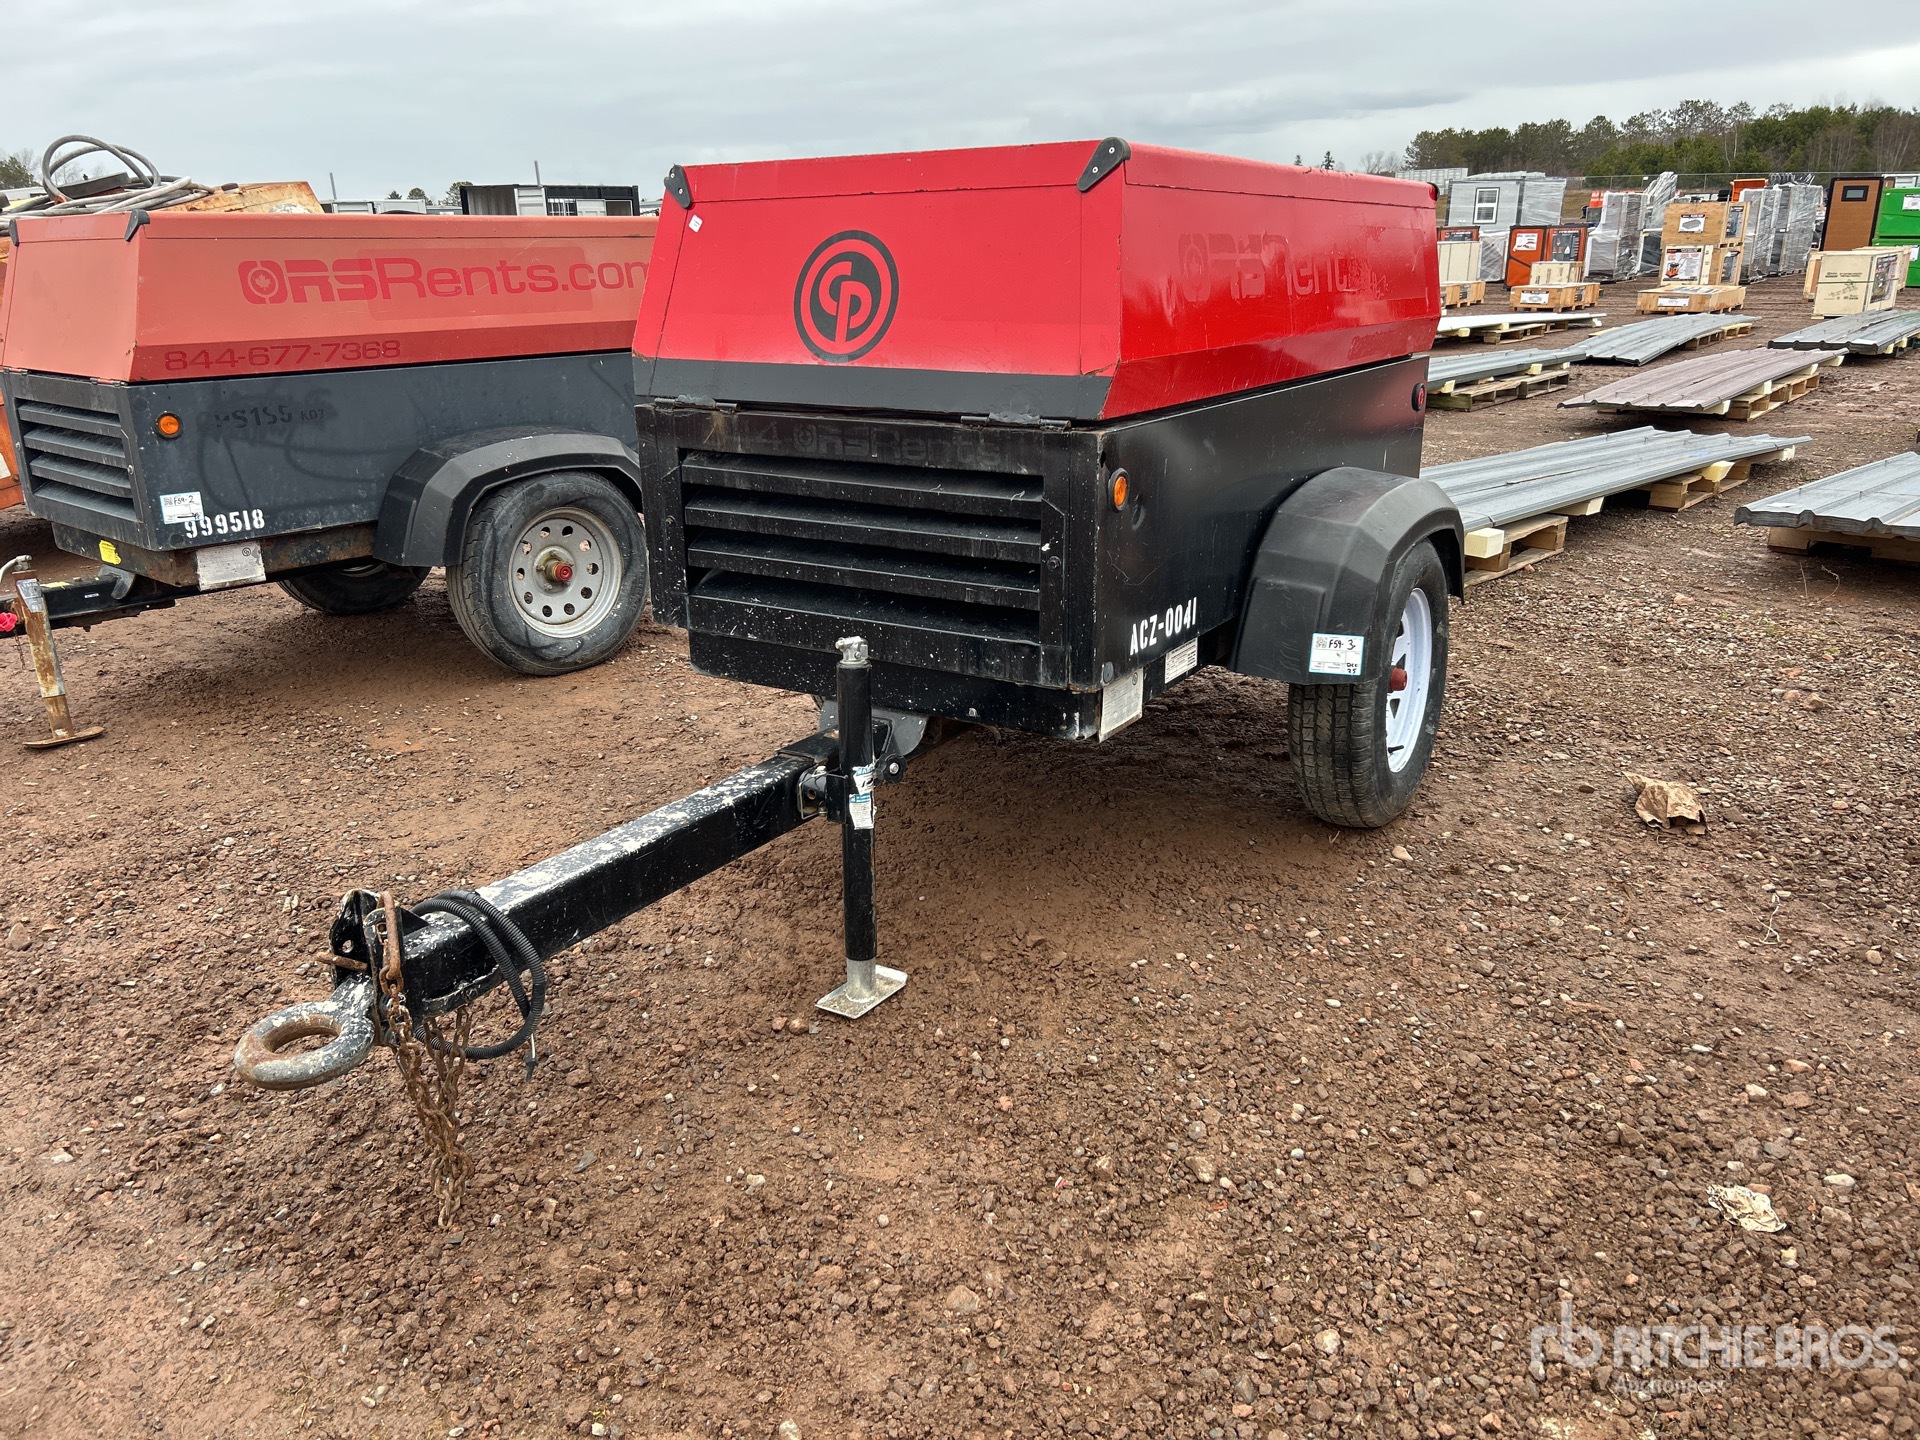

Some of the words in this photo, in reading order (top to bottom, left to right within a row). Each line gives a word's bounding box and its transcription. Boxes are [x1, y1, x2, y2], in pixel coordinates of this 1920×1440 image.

[164, 339, 401, 371] 844-677-7368
[184, 508, 265, 538] 999518
[1129, 597, 1197, 656] ACZ-0041
